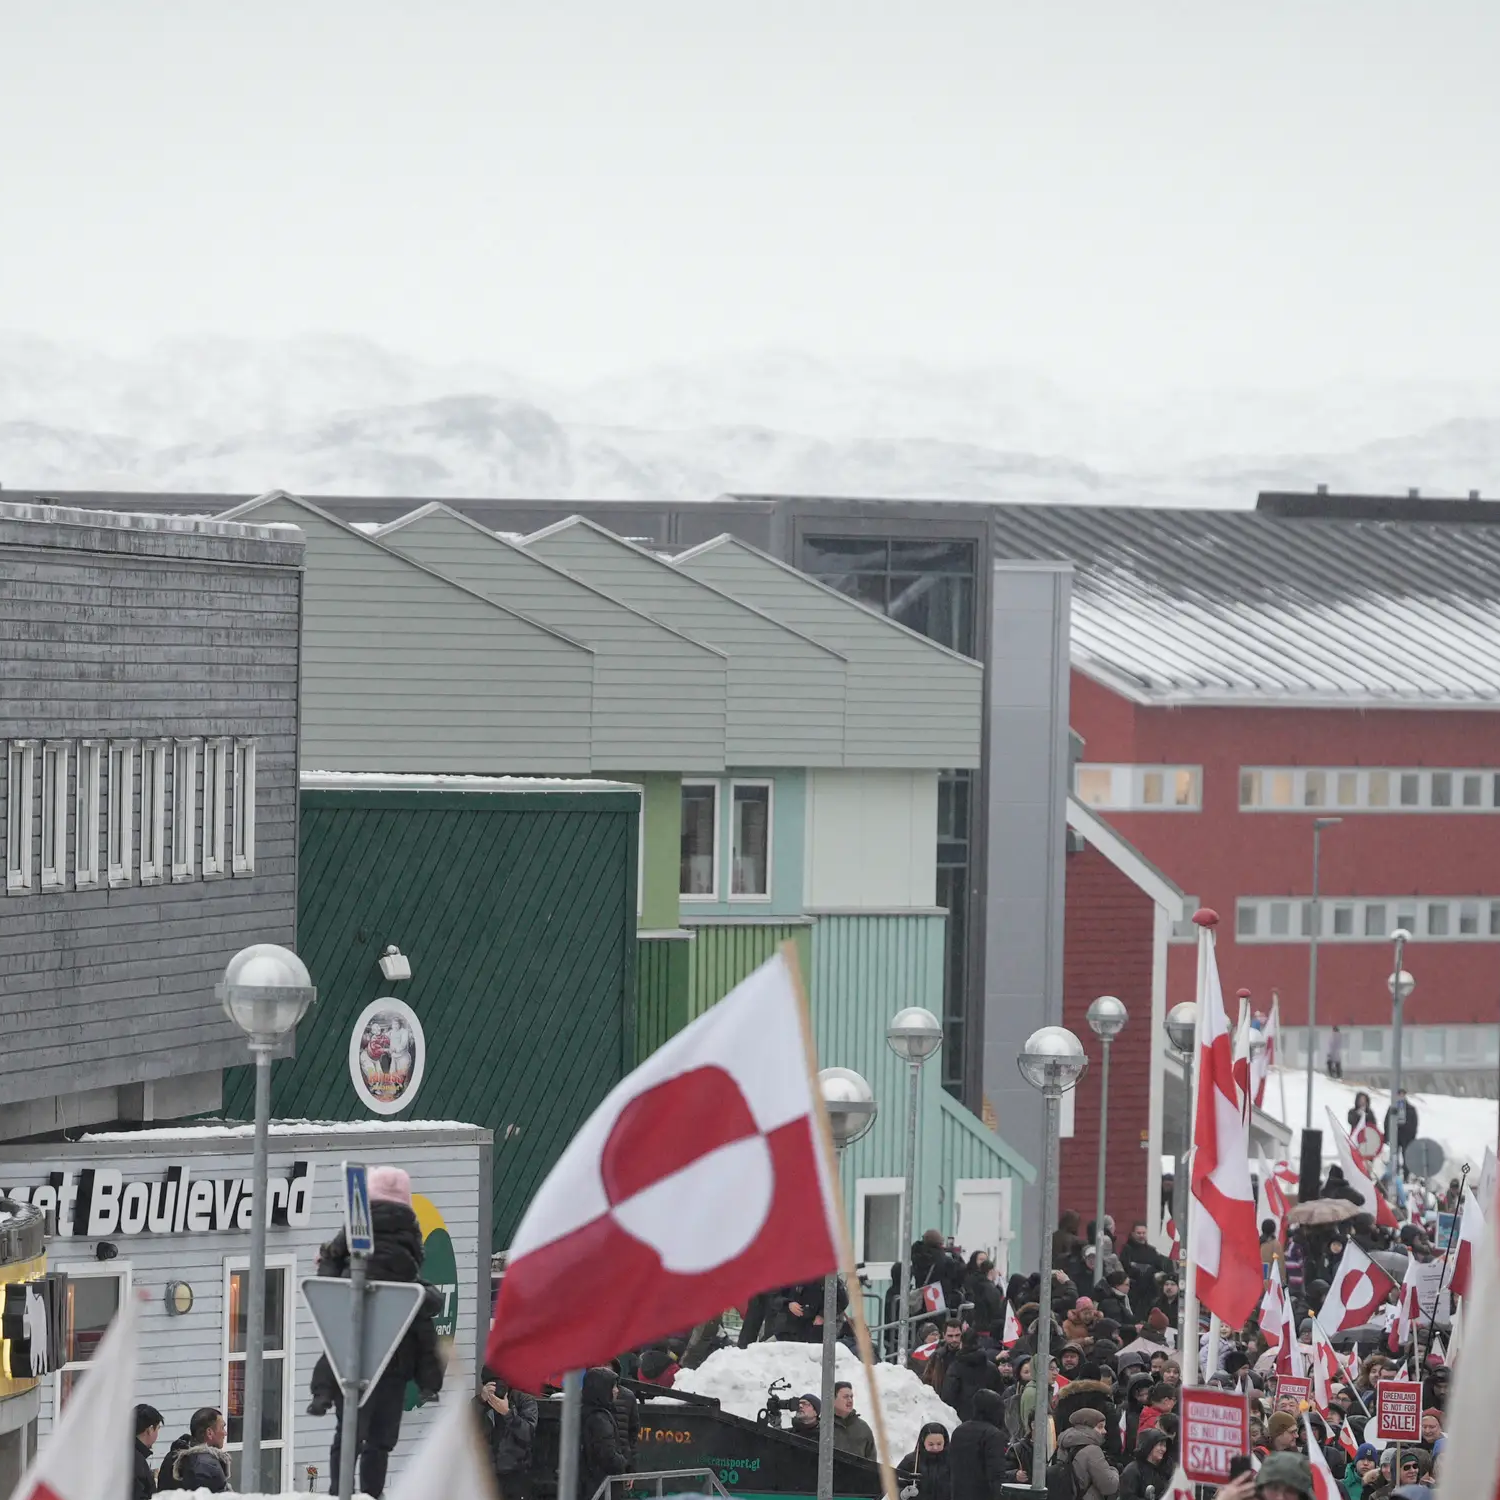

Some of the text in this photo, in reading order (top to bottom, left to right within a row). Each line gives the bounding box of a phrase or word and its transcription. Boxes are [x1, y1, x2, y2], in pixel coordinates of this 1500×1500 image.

[87, 1161, 317, 1237] Boulevard
[1384, 1392, 1416, 1401] GREENLAND
[1383, 1414, 1415, 1431] SALE!
